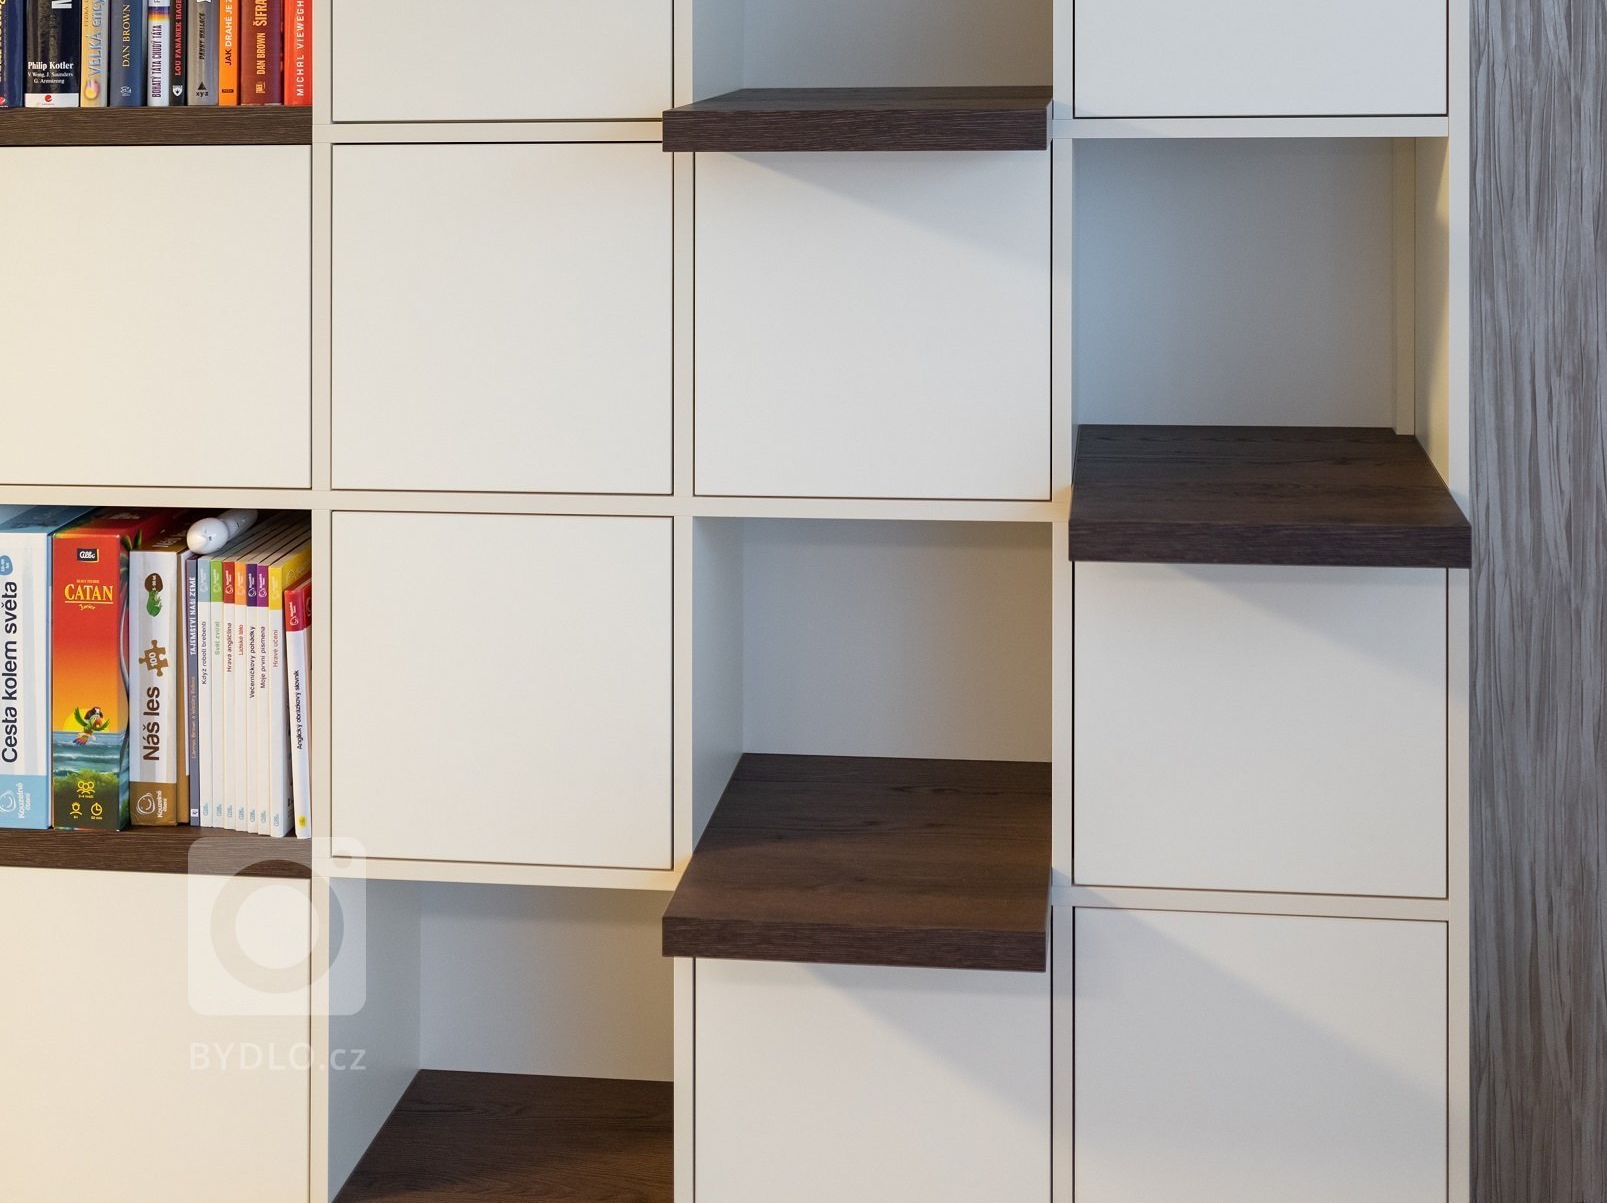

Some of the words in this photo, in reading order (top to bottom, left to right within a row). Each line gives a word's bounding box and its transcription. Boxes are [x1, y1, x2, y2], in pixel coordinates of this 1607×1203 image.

[226, 4, 233, 15] JE
[252, 0, 268, 26] ŠIFRA
[122, 4, 131, 42] BROWN
[152, 24, 162, 38] TÁTA
[224, 16, 233, 47] DRAHÉ
[296, 0, 305, 50] VIEWEGH
[86, 32, 102, 77] VELKÁ
[122, 45, 131, 67] DAN
[151, 41, 162, 59] CHUDÝ
[256, 32, 266, 58] BROWN
[28, 61, 48, 71] Philip
[49, 61, 74, 70] Kotler
[151, 60, 162, 74] TÁTA
[256, 60, 266, 75] DAN
[296, 54, 304, 96] MICHAL
[151, 76, 162, 98] BOHATÝ
[64, 583, 113, 601] CATAN
[1, 581, 17, 634] světa
[2, 640, 17, 701] kolem
[148, 652, 158, 667] 100
[142, 686, 160, 716] les
[2, 706, 17, 763] Cesta
[142, 721, 160, 761] Náš
